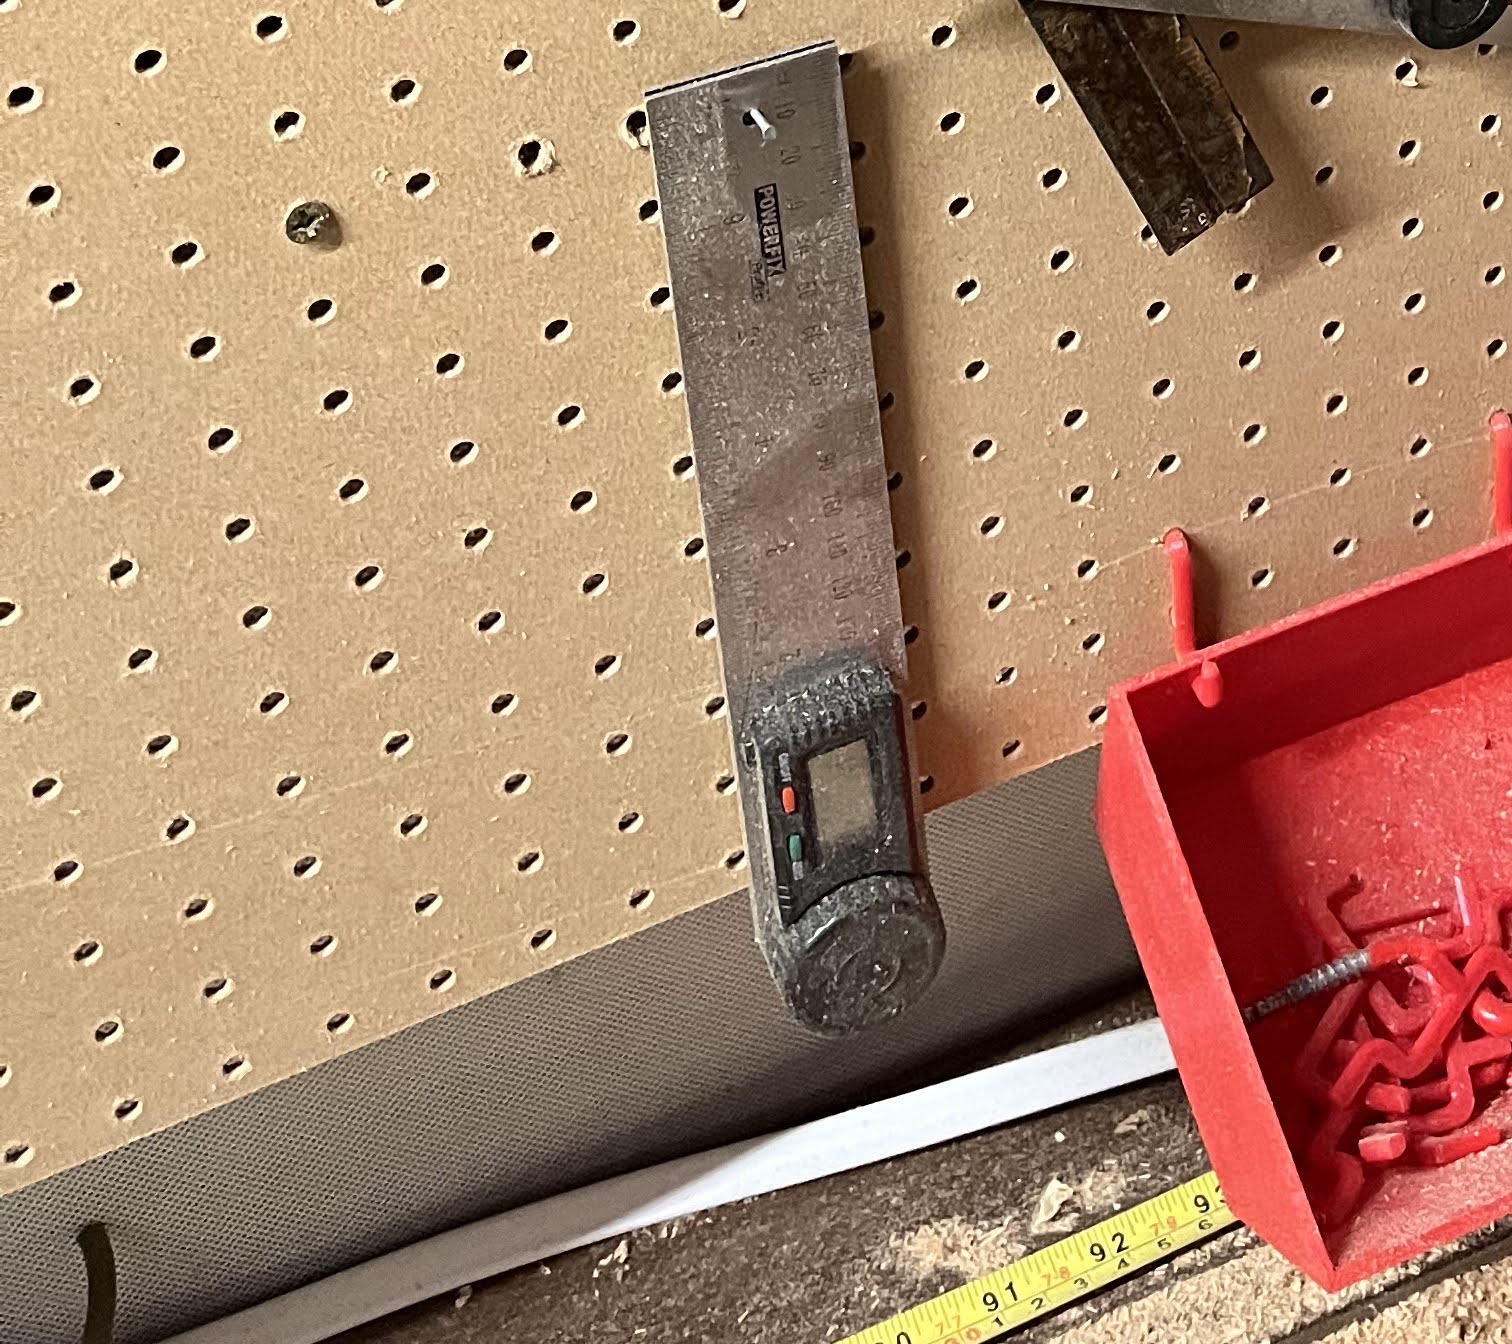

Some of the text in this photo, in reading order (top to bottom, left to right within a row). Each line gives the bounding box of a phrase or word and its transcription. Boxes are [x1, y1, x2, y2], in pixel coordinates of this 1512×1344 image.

[757, 184, 785, 275] POWERFIX
[982, 1281, 1018, 1312] 91
[1090, 1231, 1129, 1262] 92
[991, 1316, 1004, 1327] 1
[1031, 1297, 1047, 1311] 2
[1073, 1277, 1090, 1291] 3
[1116, 1257, 1131, 1271] 4
[1157, 1237, 1172, 1251] 5
[1197, 1218, 1213, 1231] 6
